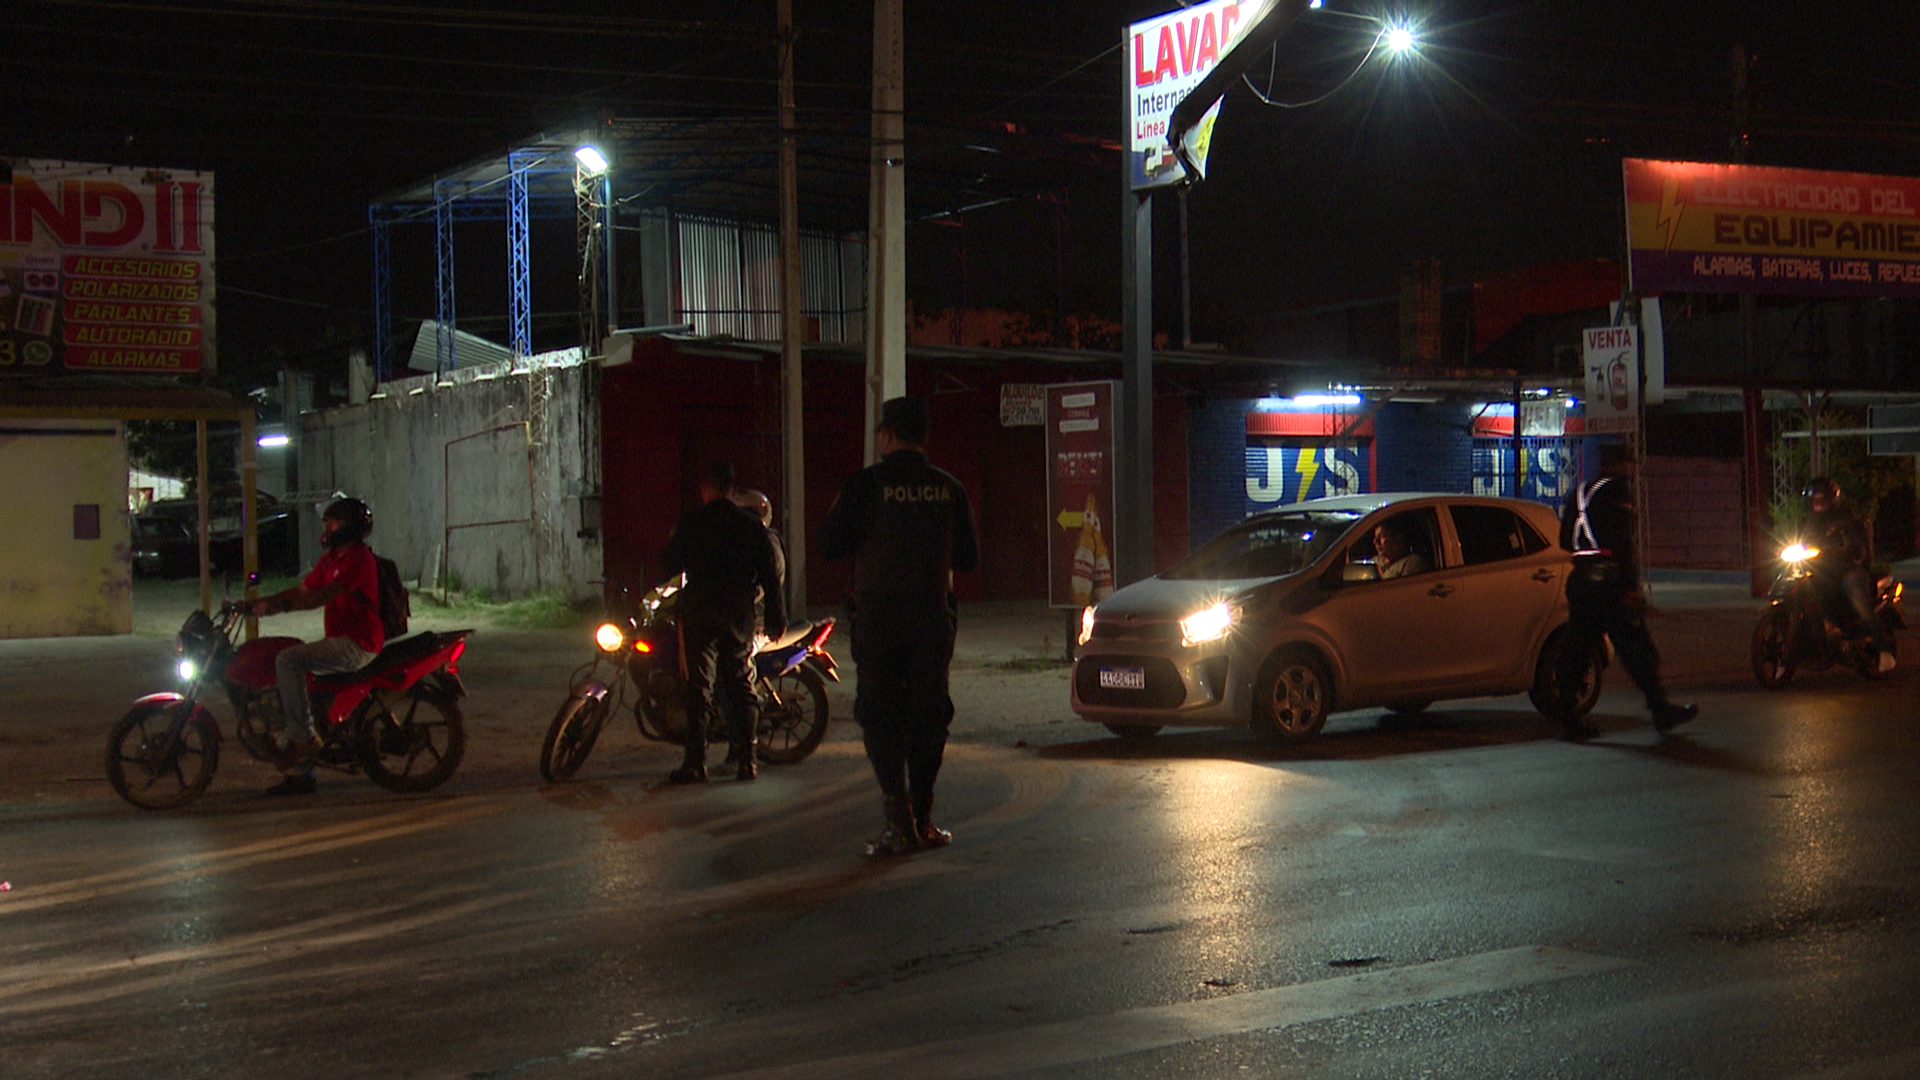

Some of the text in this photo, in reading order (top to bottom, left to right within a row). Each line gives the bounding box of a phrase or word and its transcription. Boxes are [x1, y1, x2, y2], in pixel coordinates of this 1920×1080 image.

[1137, 121, 1165, 140] Linea
[1695, 177, 1916, 216] ELECTRICIDAD DEL
[1715, 214, 1920, 253] EQUIPAMIE
[74, 258, 197, 278] ACCESORIOS
[1693, 255, 1755, 280] ALARMAS,
[1761, 258, 1825, 283] BATERIAS,
[1830, 261, 1872, 284] LUCES,
[71, 280, 199, 301] POLARIZADOS
[74, 303, 191, 323] PARLANTES
[76, 327, 192, 345] AUTORADIO
[1588, 329, 1632, 350] VENTA
[86, 350, 182, 368] ALARMAS
[883, 486, 952, 502] POLICIA
